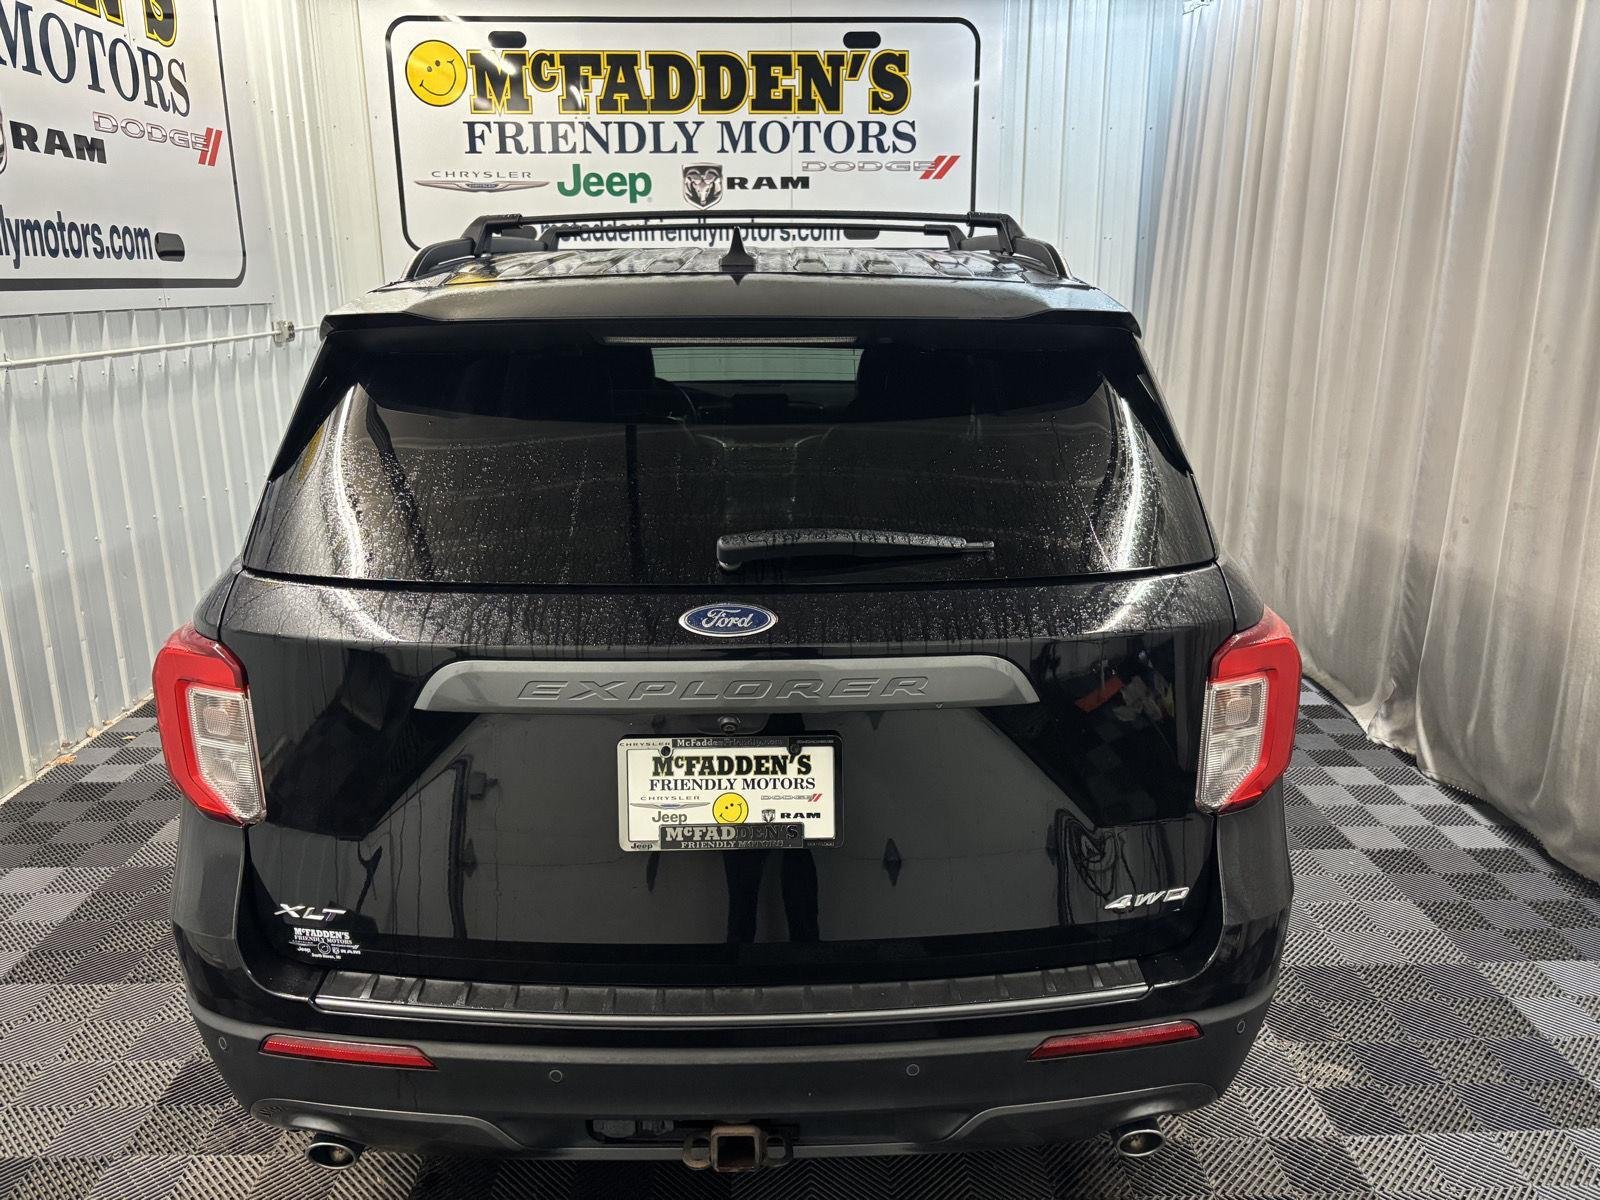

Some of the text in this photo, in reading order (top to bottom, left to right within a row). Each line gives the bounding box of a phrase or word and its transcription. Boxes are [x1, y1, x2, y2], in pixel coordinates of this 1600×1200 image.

[0, 0, 191, 118] MOTORS
[9, 120, 107, 164] RAM
[92, 111, 209, 152] DODGE
[462, 119, 917, 155] FRIENDLY MOTORS
[431, 170, 532, 179] CHRYSLER
[801, 160, 936, 172] DODGE
[556, 163, 651, 203] Jeep
[727, 176, 810, 190] RAM
[0, 204, 153, 270] lymotors.com
[701, 608, 754, 628] Ford
[517, 675, 931, 702] EXPLORER
[650, 778, 816, 791] FRIENDLY MOTORS
[652, 811, 688, 824] Jeep
[681, 841, 736, 849] FRIENDLY
[1105, 887, 1190, 910] 4WD
[274, 903, 347, 921] XLT
